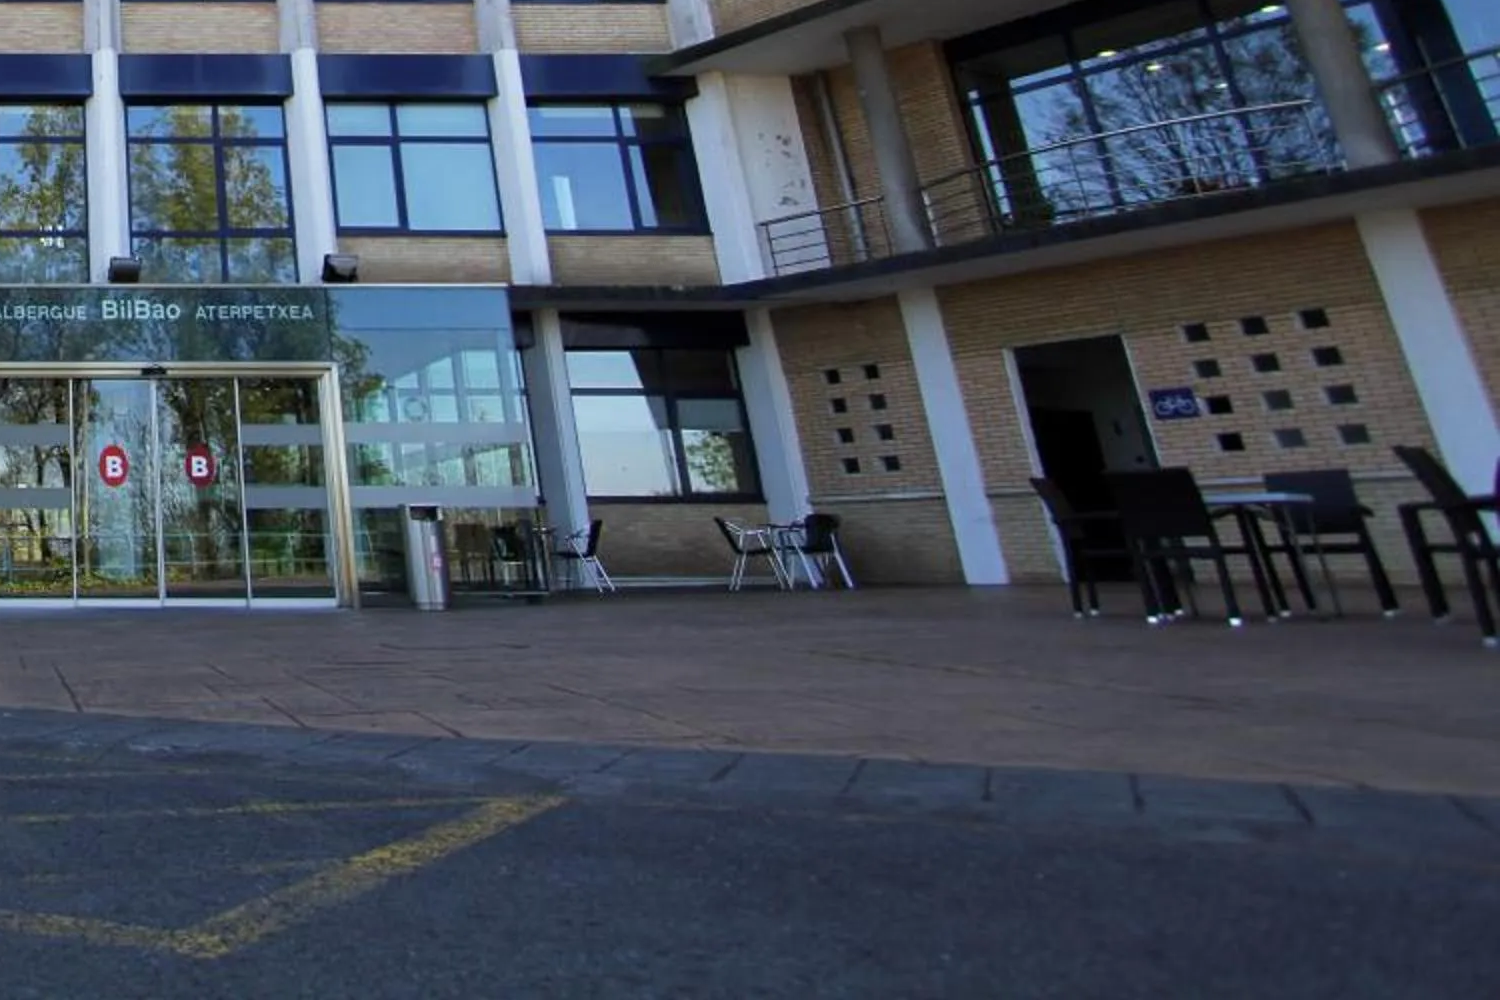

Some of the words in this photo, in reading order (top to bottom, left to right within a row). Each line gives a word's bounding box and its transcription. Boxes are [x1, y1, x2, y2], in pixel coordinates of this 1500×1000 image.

[101, 299, 182, 320] BilBao
[195, 304, 314, 320] ATERPETXEA
[105, 455, 124, 478] B
[191, 455, 209, 477] B
